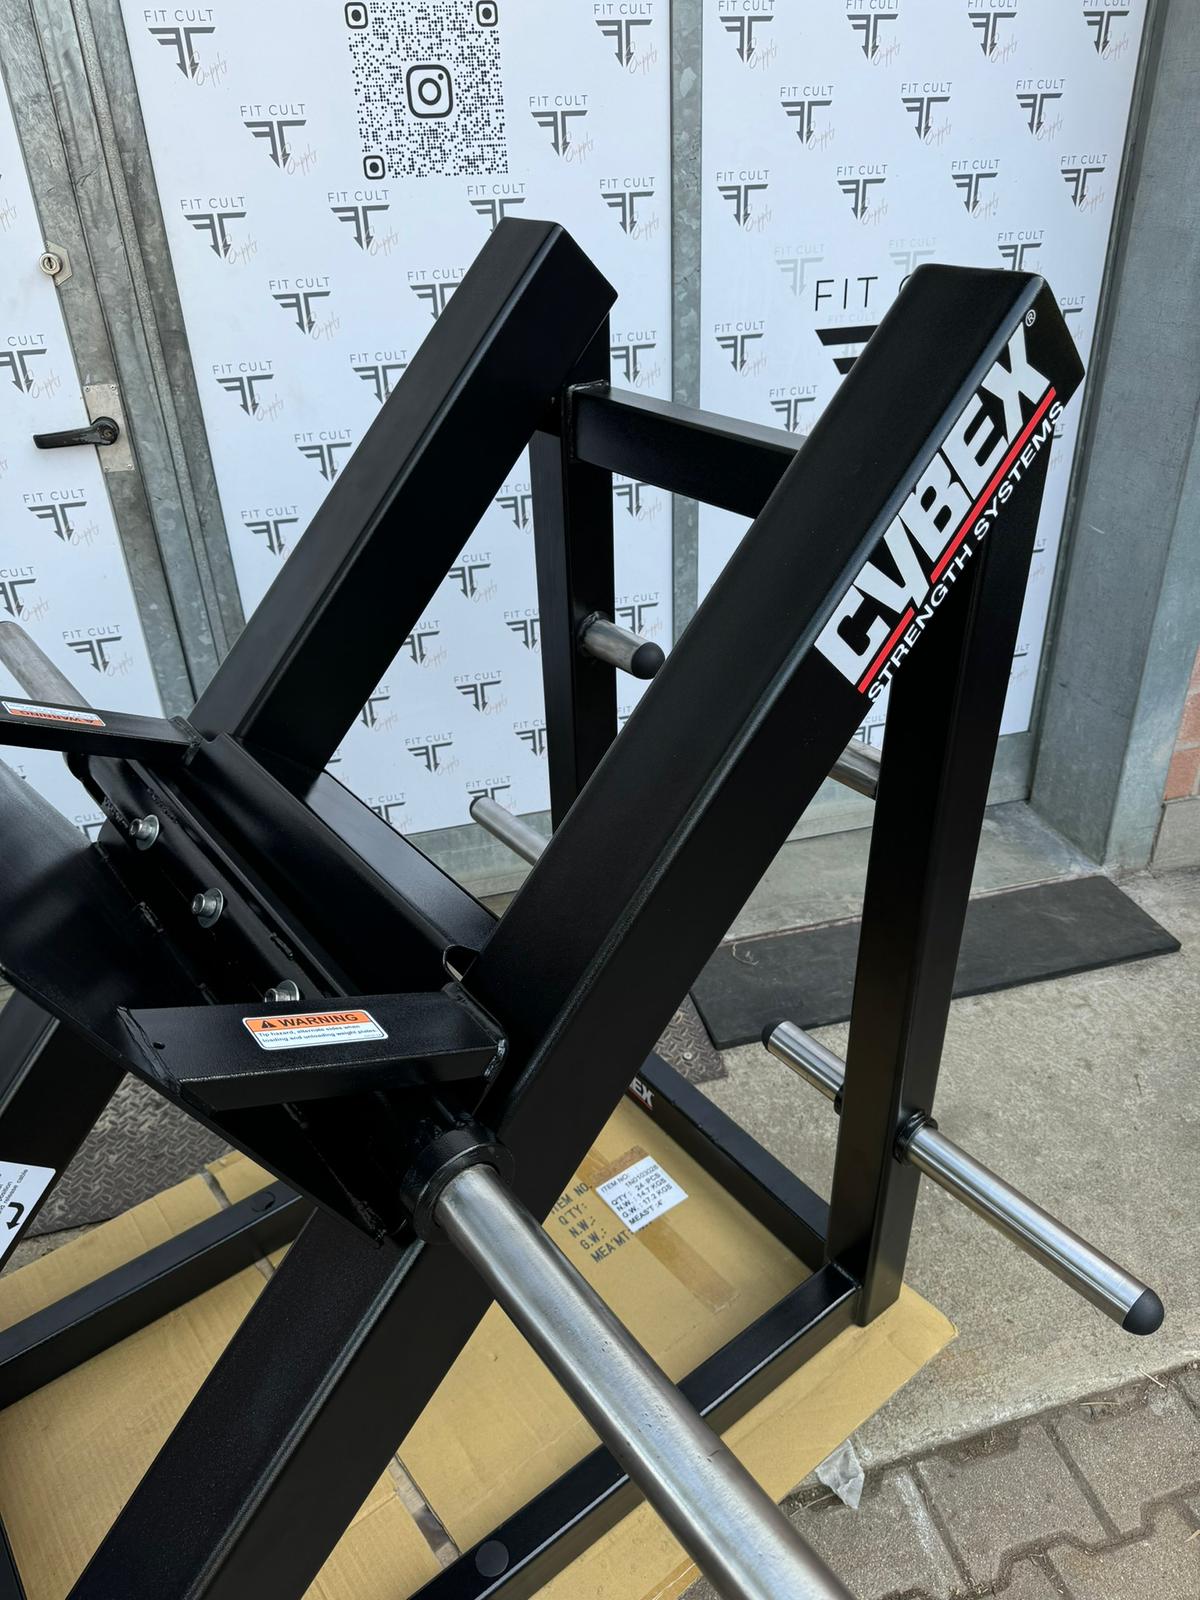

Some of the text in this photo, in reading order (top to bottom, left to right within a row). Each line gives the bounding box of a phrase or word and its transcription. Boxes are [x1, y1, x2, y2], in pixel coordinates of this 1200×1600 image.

[594, 4, 652, 14] FIT CULT
[719, 0, 775, 11] FIT CULT
[144, 9, 214, 22] FIT CULT
[901, 82, 952, 93] FIT CULT
[1016, 79, 1066, 89] FIT CULT
[780, 86, 834, 97] FIT CULT
[530, 95, 587, 106] FIT CULT
[240, 104, 305, 117] FIT CULT
[952, 159, 1000, 170] FIT CULT
[1061, 154, 1107, 165] FIT CULT
[716, 170, 769, 181] FIT CULT
[837, 165, 888, 176] FIT CULT
[600, 177, 655, 189] FIT CULT
[467, 183, 525, 196] FIT CULT
[328, 190, 389, 202] FIT CULT
[180, 197, 245, 210] FIT CULT
[998, 230, 1044, 240] FIT CULT
[407, 268, 465, 280] FIT CULT
[269, 277, 330, 290] FIT CULT
[815, 276, 878, 311] FIT
[1060, 296, 1085, 305] CULT
[714, 321, 765, 332] FIT CULT
[8, 334, 45, 346] CULT
[627, 331, 657, 342] CULT
[349, 350, 408, 363] FIT CULT
[212, 361, 273, 374] FIT CULT
[769, 385, 818, 398] FIT CULT
[294, 429, 352, 443] FIT CULT
[23, 489, 85, 503] FIT CULT
[814, 321, 1052, 686] CYBEX
[241, 505, 298, 519] FIT CULT
[867, 401, 1064, 702] STRENGTH SYSTEMS
[462, 553, 491, 563] CULT
[0, 567, 34, 578] CULT
[633, 592, 660, 602] CULT
[62, 625, 120, 640] FIT CULT
[453, 671, 502, 683] FIT CULT
[513, 721, 528, 729] FIT
[405, 732, 453, 746] FIT CULT
[466, 776, 511, 789] FIT CULT
[378, 793, 406, 802] CULT
[278, 1014, 358, 1027] WARNING
